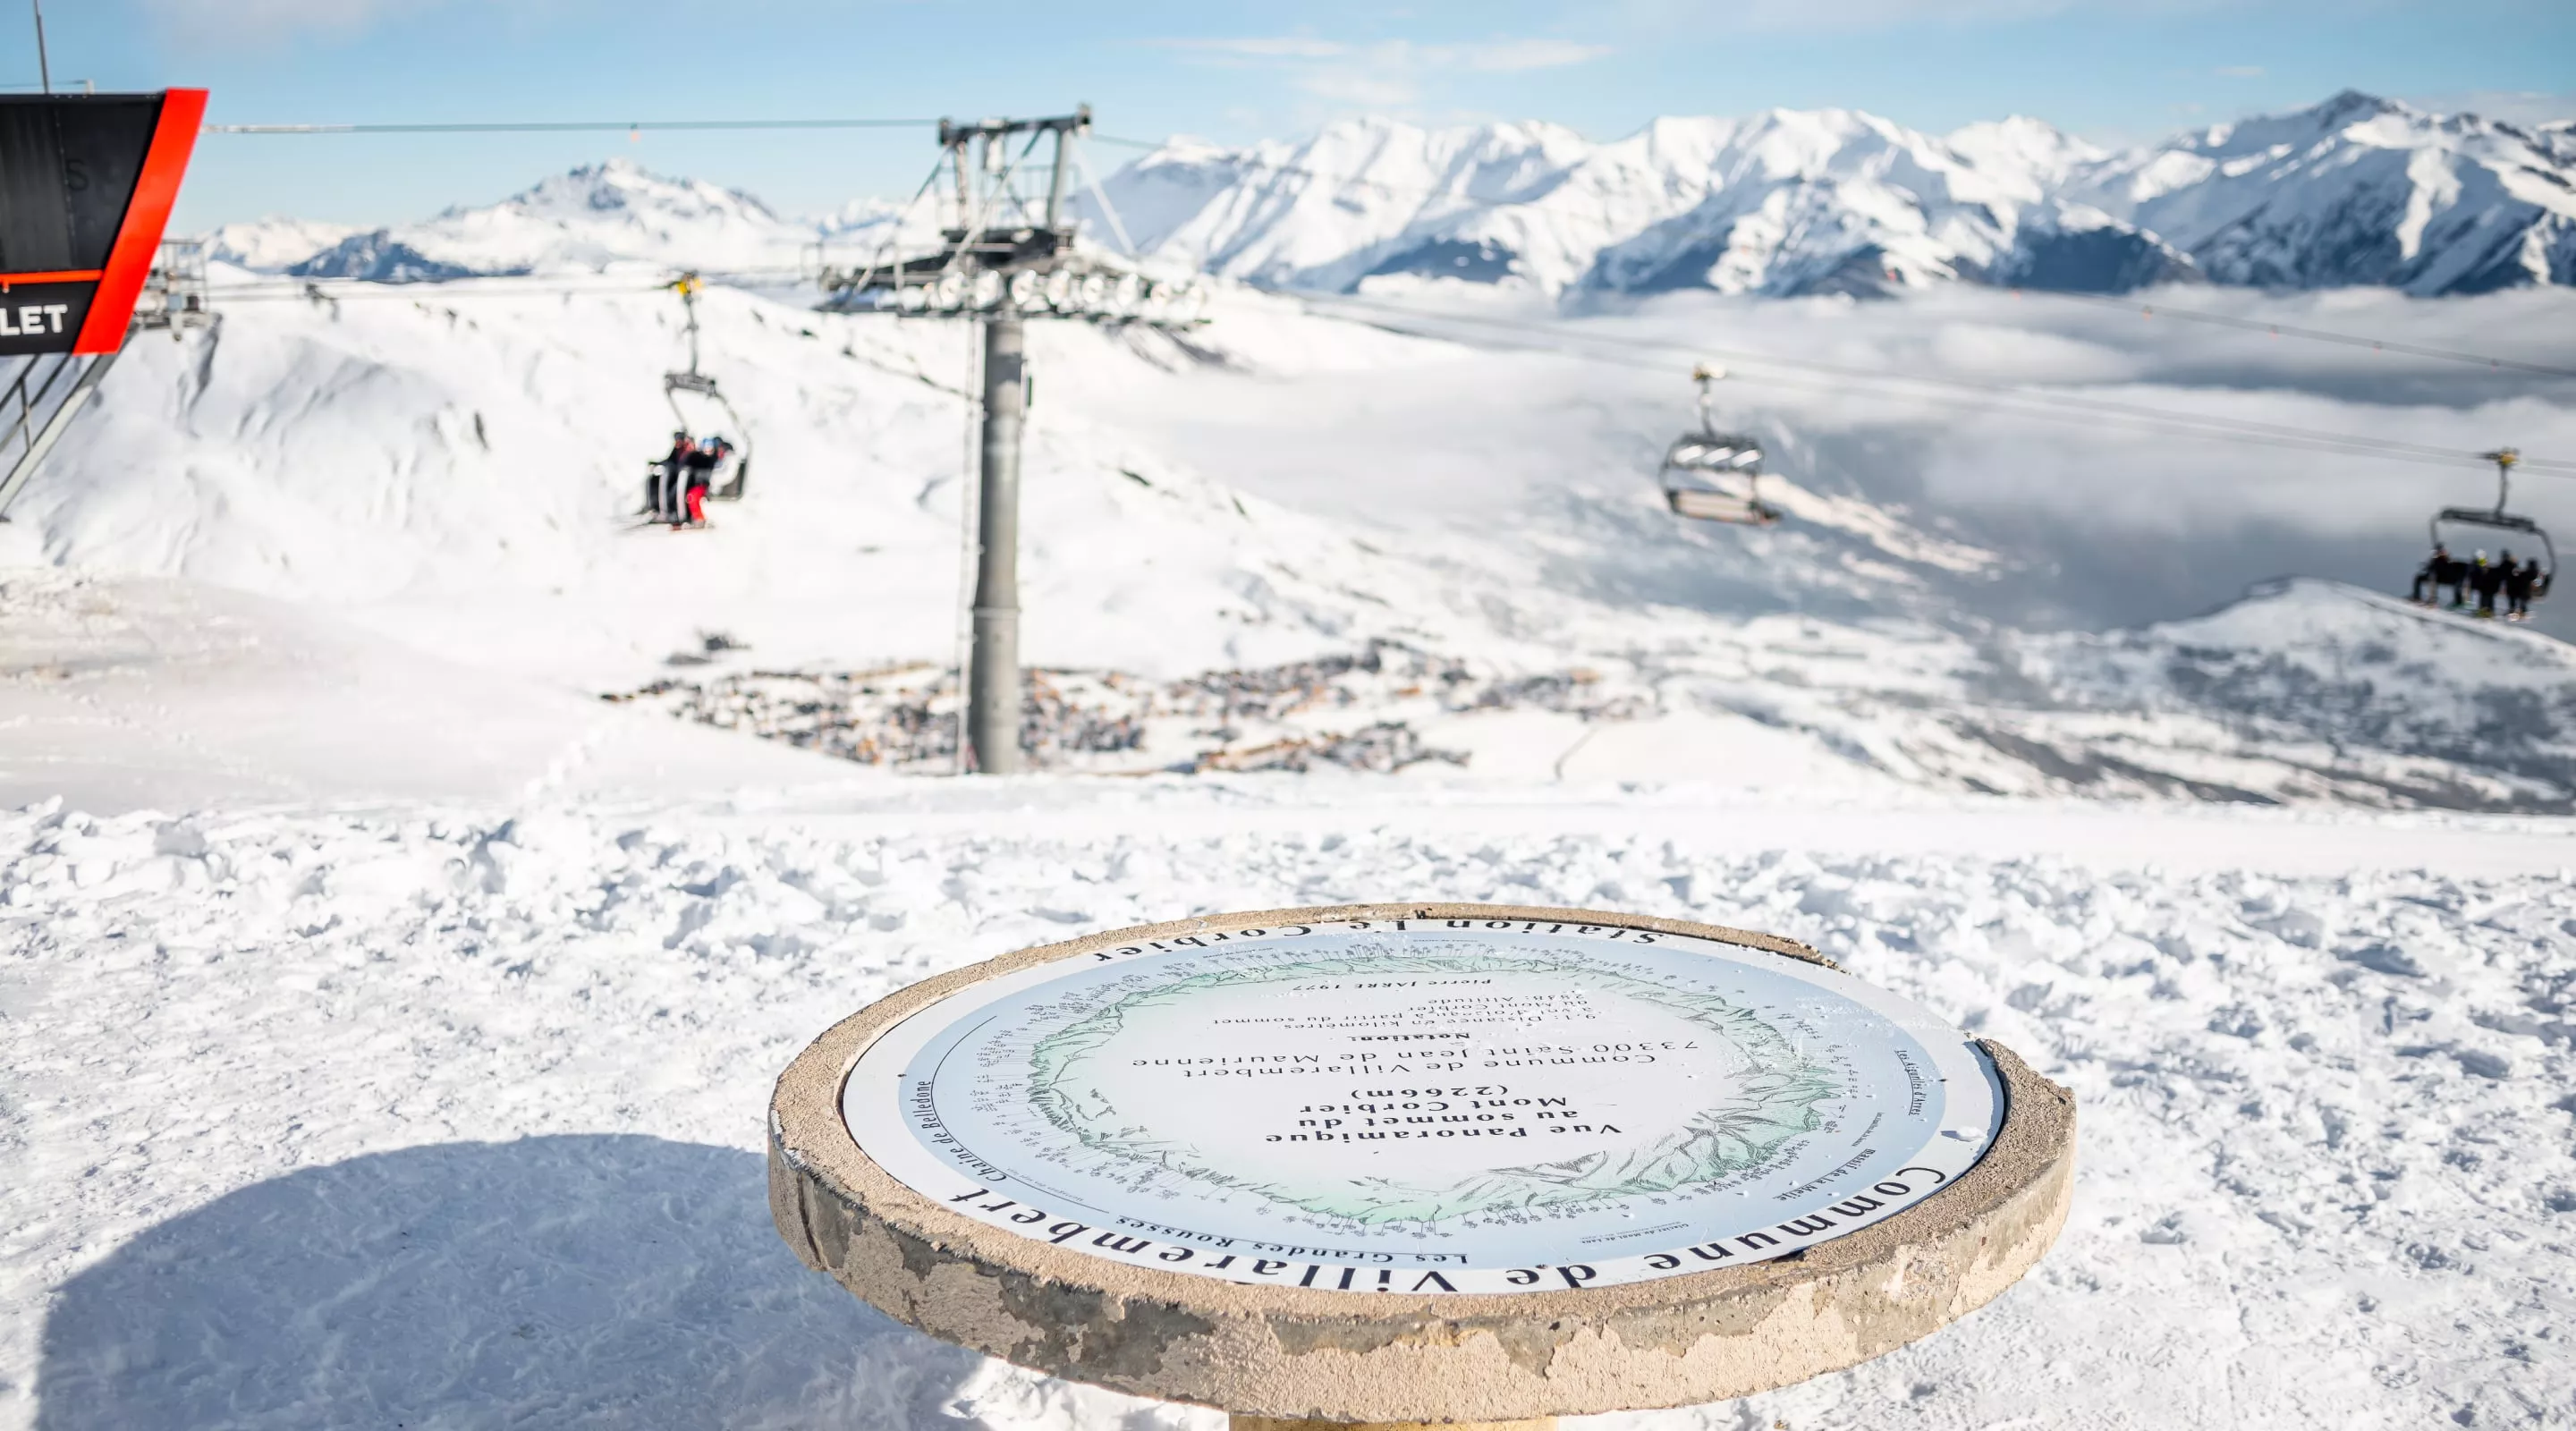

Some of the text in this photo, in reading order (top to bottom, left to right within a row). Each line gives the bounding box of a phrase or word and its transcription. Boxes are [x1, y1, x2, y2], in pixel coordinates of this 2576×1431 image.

[1446, 919, 1664, 944] Station
[1093, 925, 1311, 962] Corbier
[1354, 981, 1417, 990] JARRE
[1408, 1004, 1488, 1012] Corbier
[1428, 996, 1513, 1005] Altitude
[1212, 1017, 1295, 1025] sommet
[1343, 1012, 1402, 1021] partir
[1446, 1015, 1542, 1024] Distance
[1284, 1020, 1399, 1029] kilomètres
[1350, 1032, 1470, 1043] Notation:
[1132, 1041, 1699, 1066] 73300 Saint Jean de Maurienne
[1182, 1054, 1656, 1078] Commune de Villarembert
[1351, 1085, 1508, 1099] (2266m)
[1300, 1097, 1566, 1114] Mont Corbier
[1909, 1091, 1927, 1116] d'Arves
[1298, 1111, 1578, 1129] au sommet du
[934, 1132, 953, 1147] de
[1266, 1124, 1622, 1143] Vue Panoramique
[1833, 1169, 1848, 1178] de
[950, 1166, 1946, 1292] Commune de Villarembert
[1115, 1217, 1467, 1264] Les Grandes Rousses
